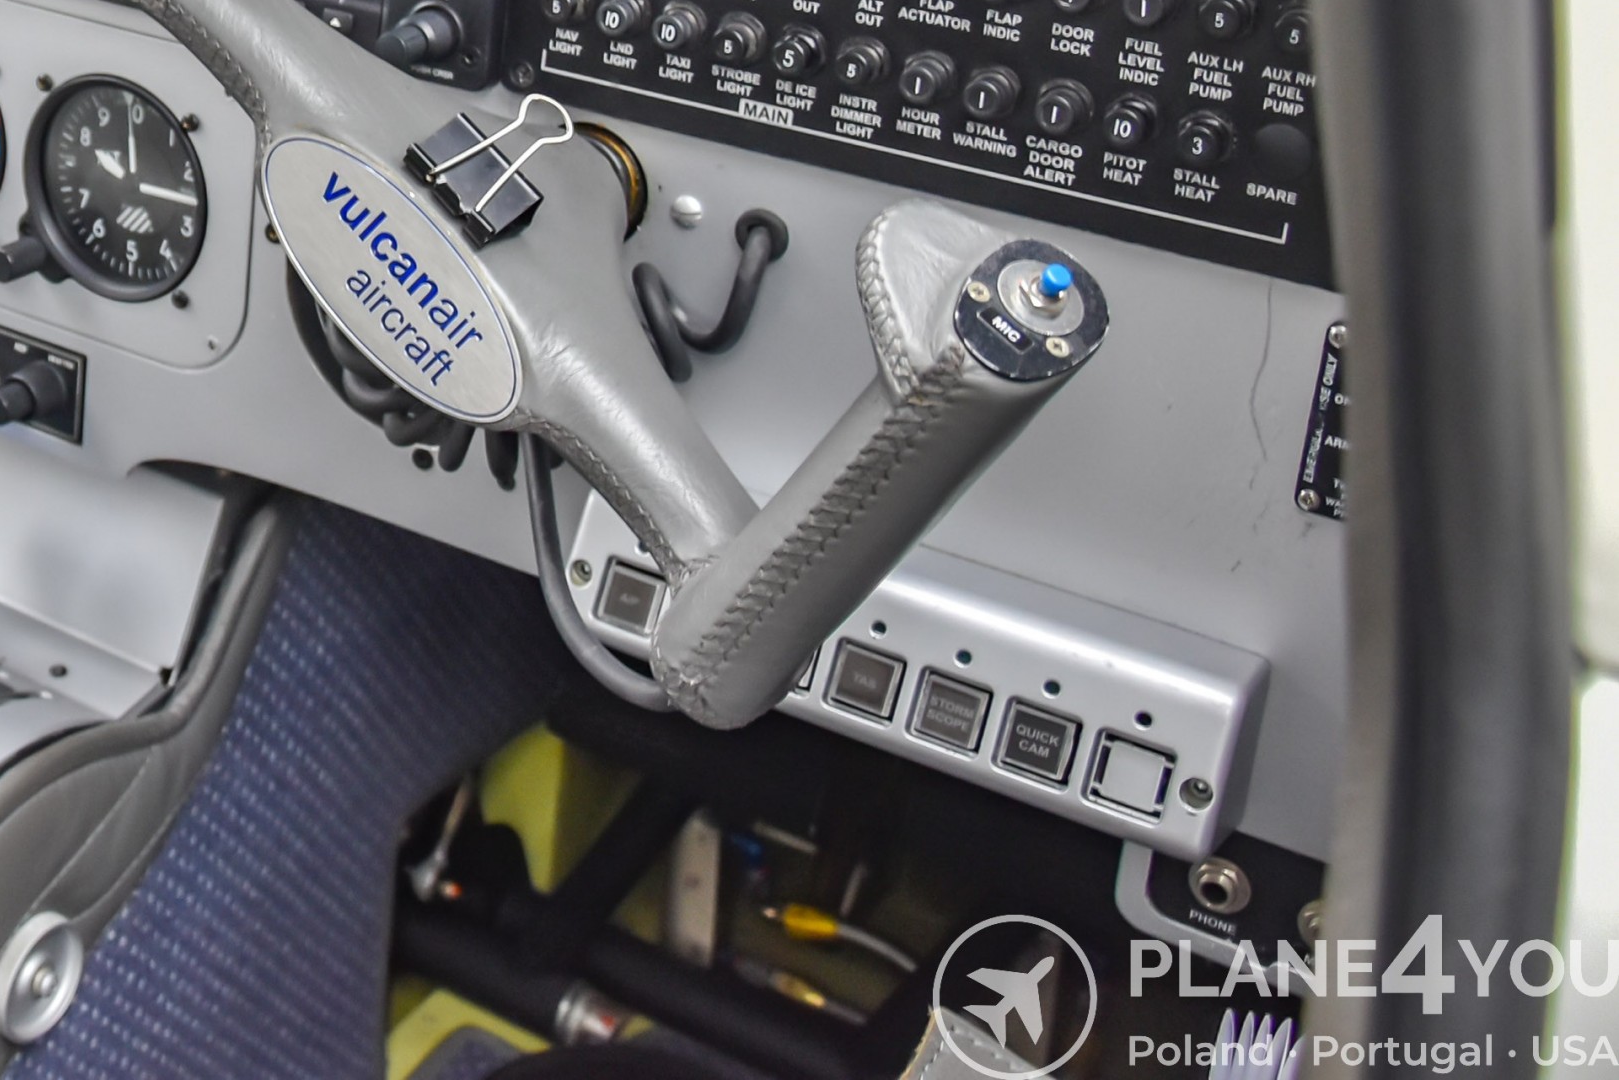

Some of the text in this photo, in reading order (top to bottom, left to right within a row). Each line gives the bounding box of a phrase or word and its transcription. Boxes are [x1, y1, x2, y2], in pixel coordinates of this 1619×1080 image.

[855, 11, 883, 28] OUT
[898, 7, 971, 32] ACTUATOR
[986, 9, 1022, 26] FLAP
[983, 24, 1020, 42] INDIC
[1052, 23, 1094, 42] DOOR
[1050, 38, 1091, 56] LOCK
[1125, 37, 1162, 56] FUEL
[1118, 52, 1164, 72] LEVEL
[1187, 51, 1244, 73] AUX LH
[1119, 68, 1159, 86] INDIC
[1194, 68, 1232, 87] FUEL
[1262, 66, 1316, 87] AUX RH
[1189, 83, 1232, 101] PUMP
[1268, 82, 1303, 101] FUEL
[98, 107, 110, 127] 9
[132, 104, 143, 124] 0
[744, 103, 790, 124] MAIN
[1263, 98, 1304, 117] PUMP
[80, 127, 91, 147] 8
[966, 121, 1008, 141] STALL
[953, 132, 1017, 158] WARNING
[1026, 135, 1082, 158] CARGO
[1029, 150, 1074, 171] DOOR
[1103, 152, 1147, 172] PITOT
[1024, 165, 1076, 187] ALERT
[1103, 167, 1142, 186] HEAT
[1173, 169, 1221, 189] STALL
[79, 188, 90, 208] 7
[1174, 183, 1215, 202] HEAT
[1246, 183, 1297, 205] SPARE
[92, 219, 106, 238] 6
[181, 216, 193, 237] 3
[126, 240, 138, 261] 5
[321, 172, 483, 349] vulcanair
[346, 269, 454, 386] aircraft
[992, 316, 1021, 343] MIC
[932, 695, 974, 718] STORM
[927, 709, 968, 731] SCOPE
[1016, 724, 1060, 747] QUICK
[1019, 740, 1050, 759] CAM
[1189, 909, 1236, 936] PHONE
